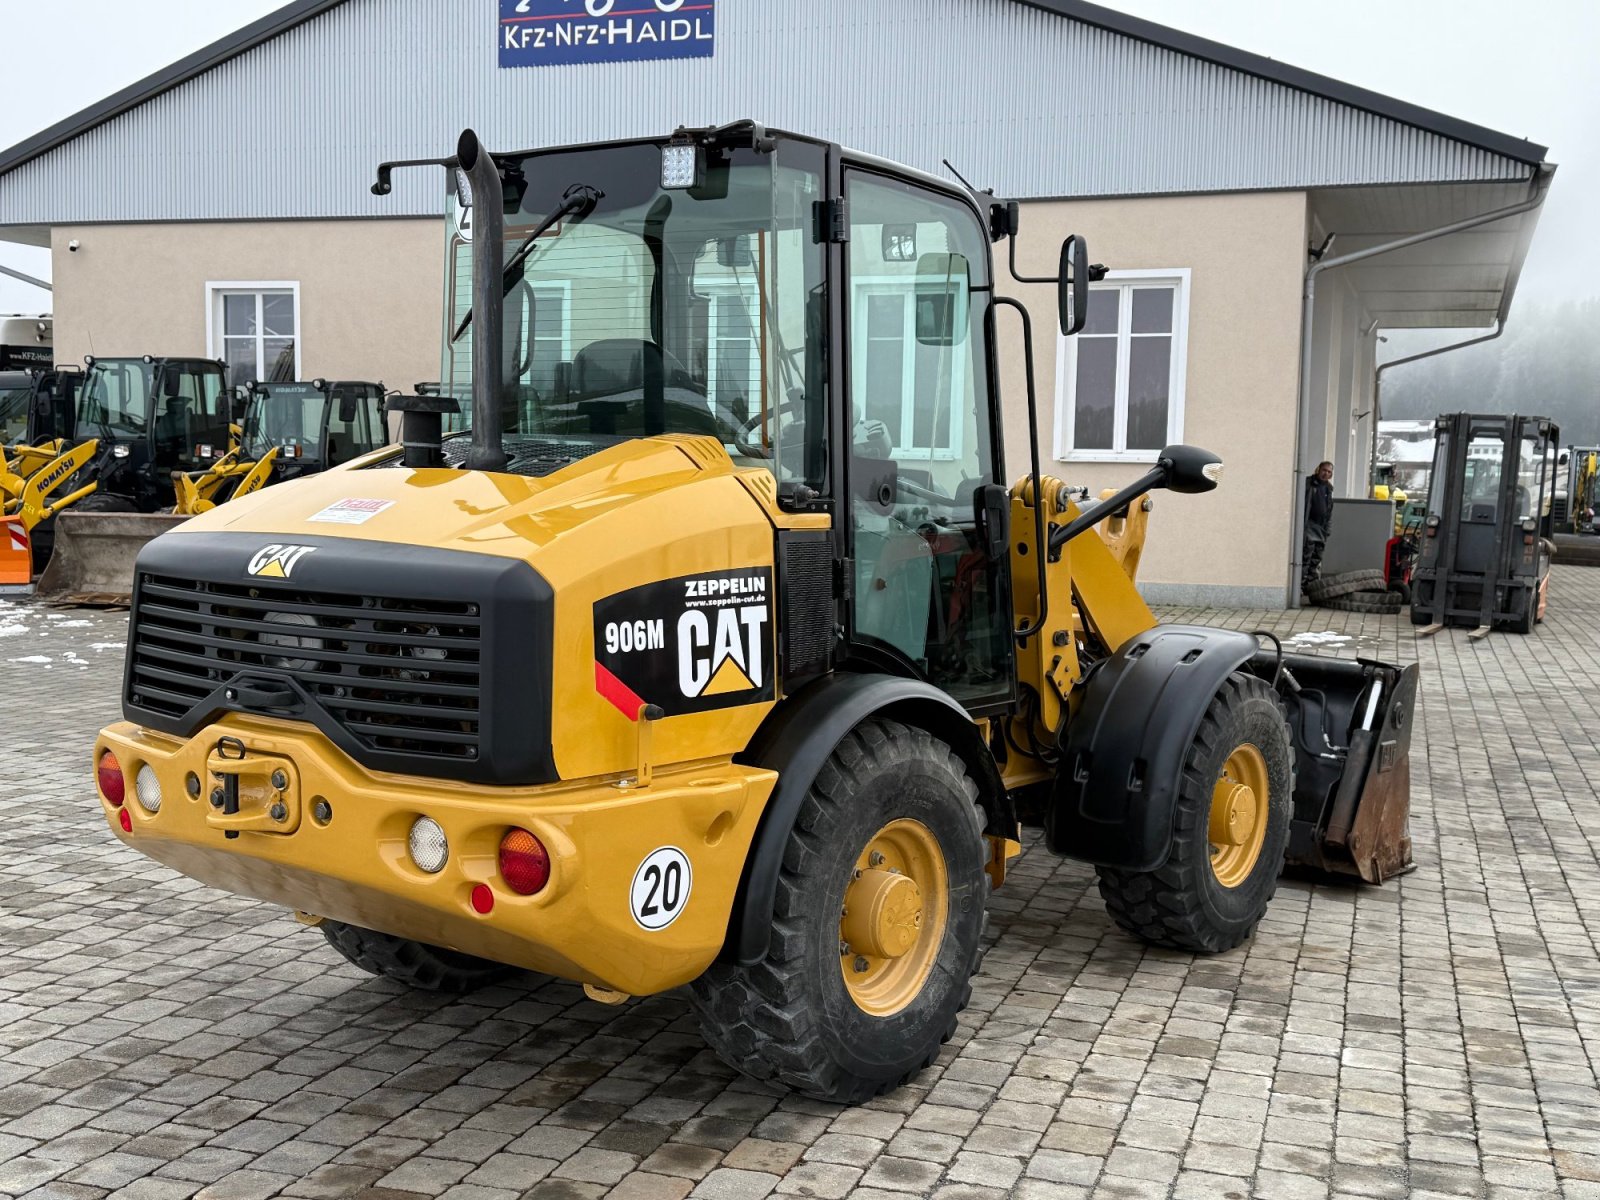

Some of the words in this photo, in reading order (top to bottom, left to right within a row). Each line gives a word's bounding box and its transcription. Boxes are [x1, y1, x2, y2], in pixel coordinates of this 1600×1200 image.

[36, 457, 75, 493] KOMATSU
[247, 544, 318, 578] CAT
[685, 576, 766, 597] ZEPPELIN
[605, 618, 665, 654] 906M
[677, 604, 768, 698] CAT
[640, 860, 682, 918] 20
